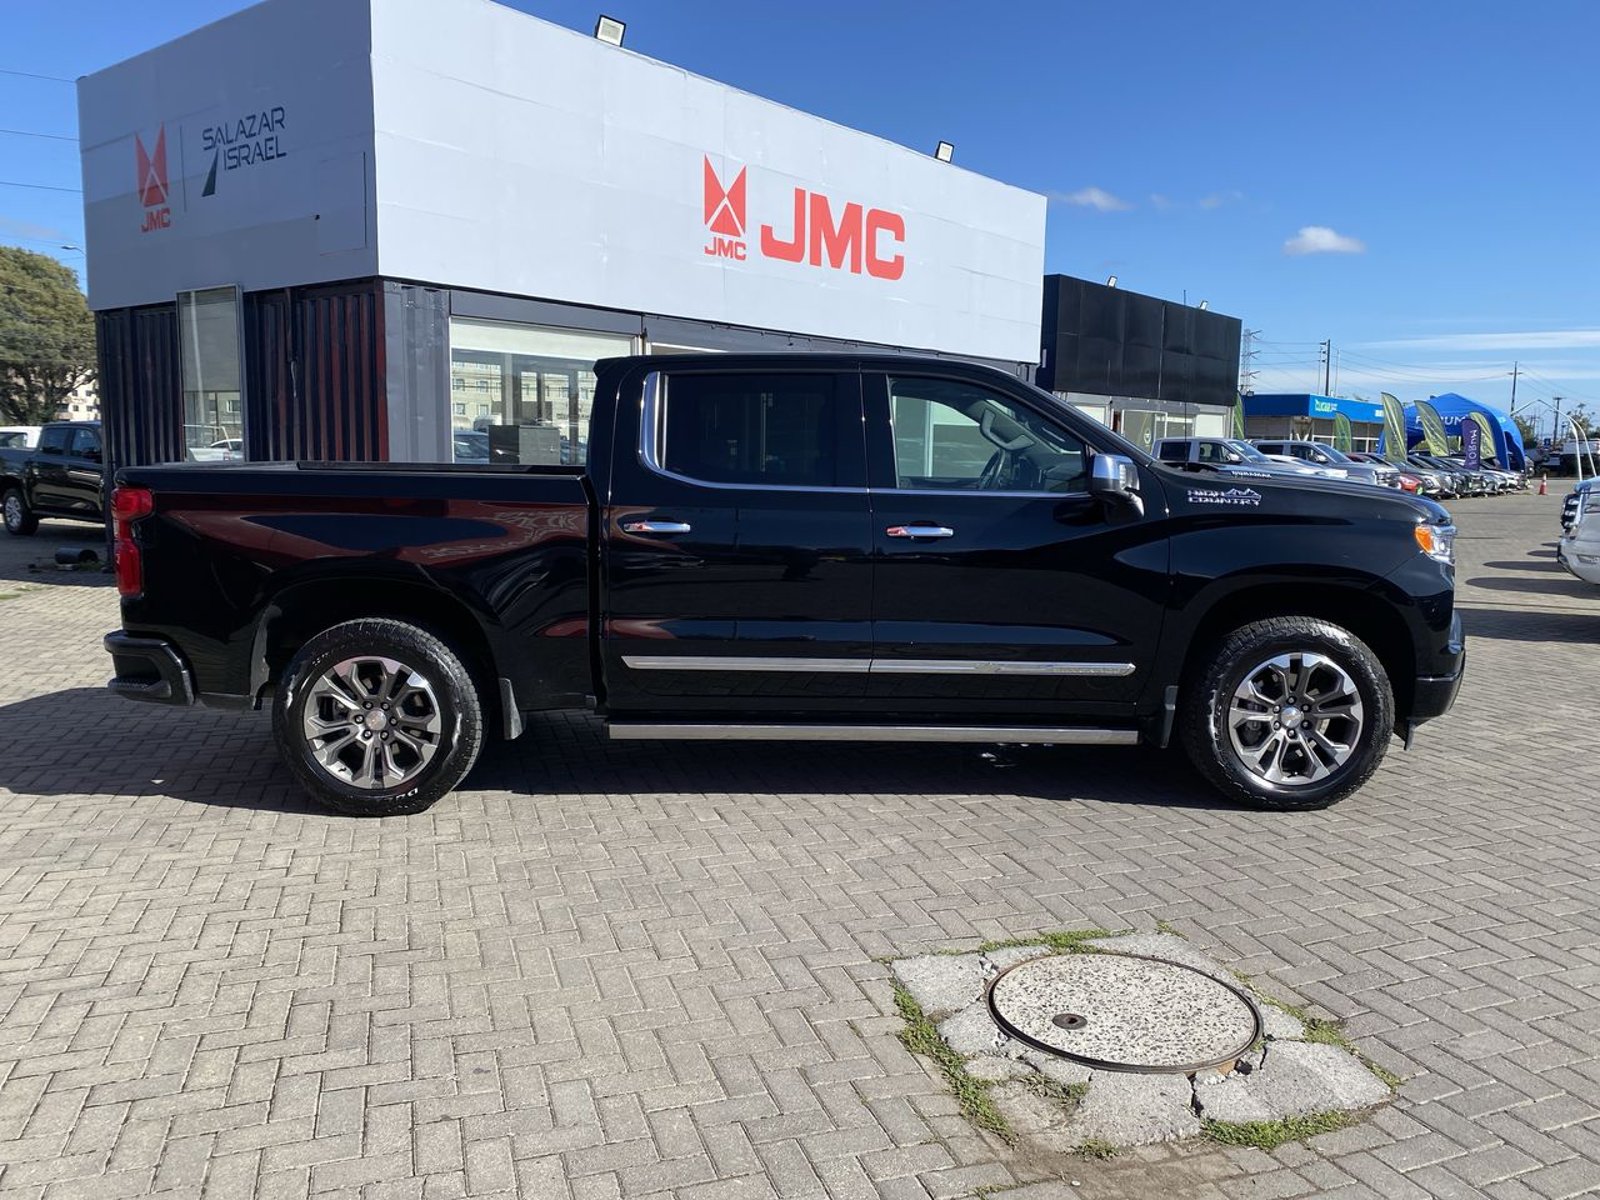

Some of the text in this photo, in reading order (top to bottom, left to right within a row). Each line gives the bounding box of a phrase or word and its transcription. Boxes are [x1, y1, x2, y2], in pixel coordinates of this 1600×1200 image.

[202, 106, 286, 151] SALAZAR
[224, 136, 288, 171] ISRAEL
[141, 207, 171, 233] JMC
[760, 187, 906, 281] JMC
[704, 236, 747, 261] JMC
[1415, 414, 1468, 426] FUM
[1187, 496, 1260, 507] COUNTRY
